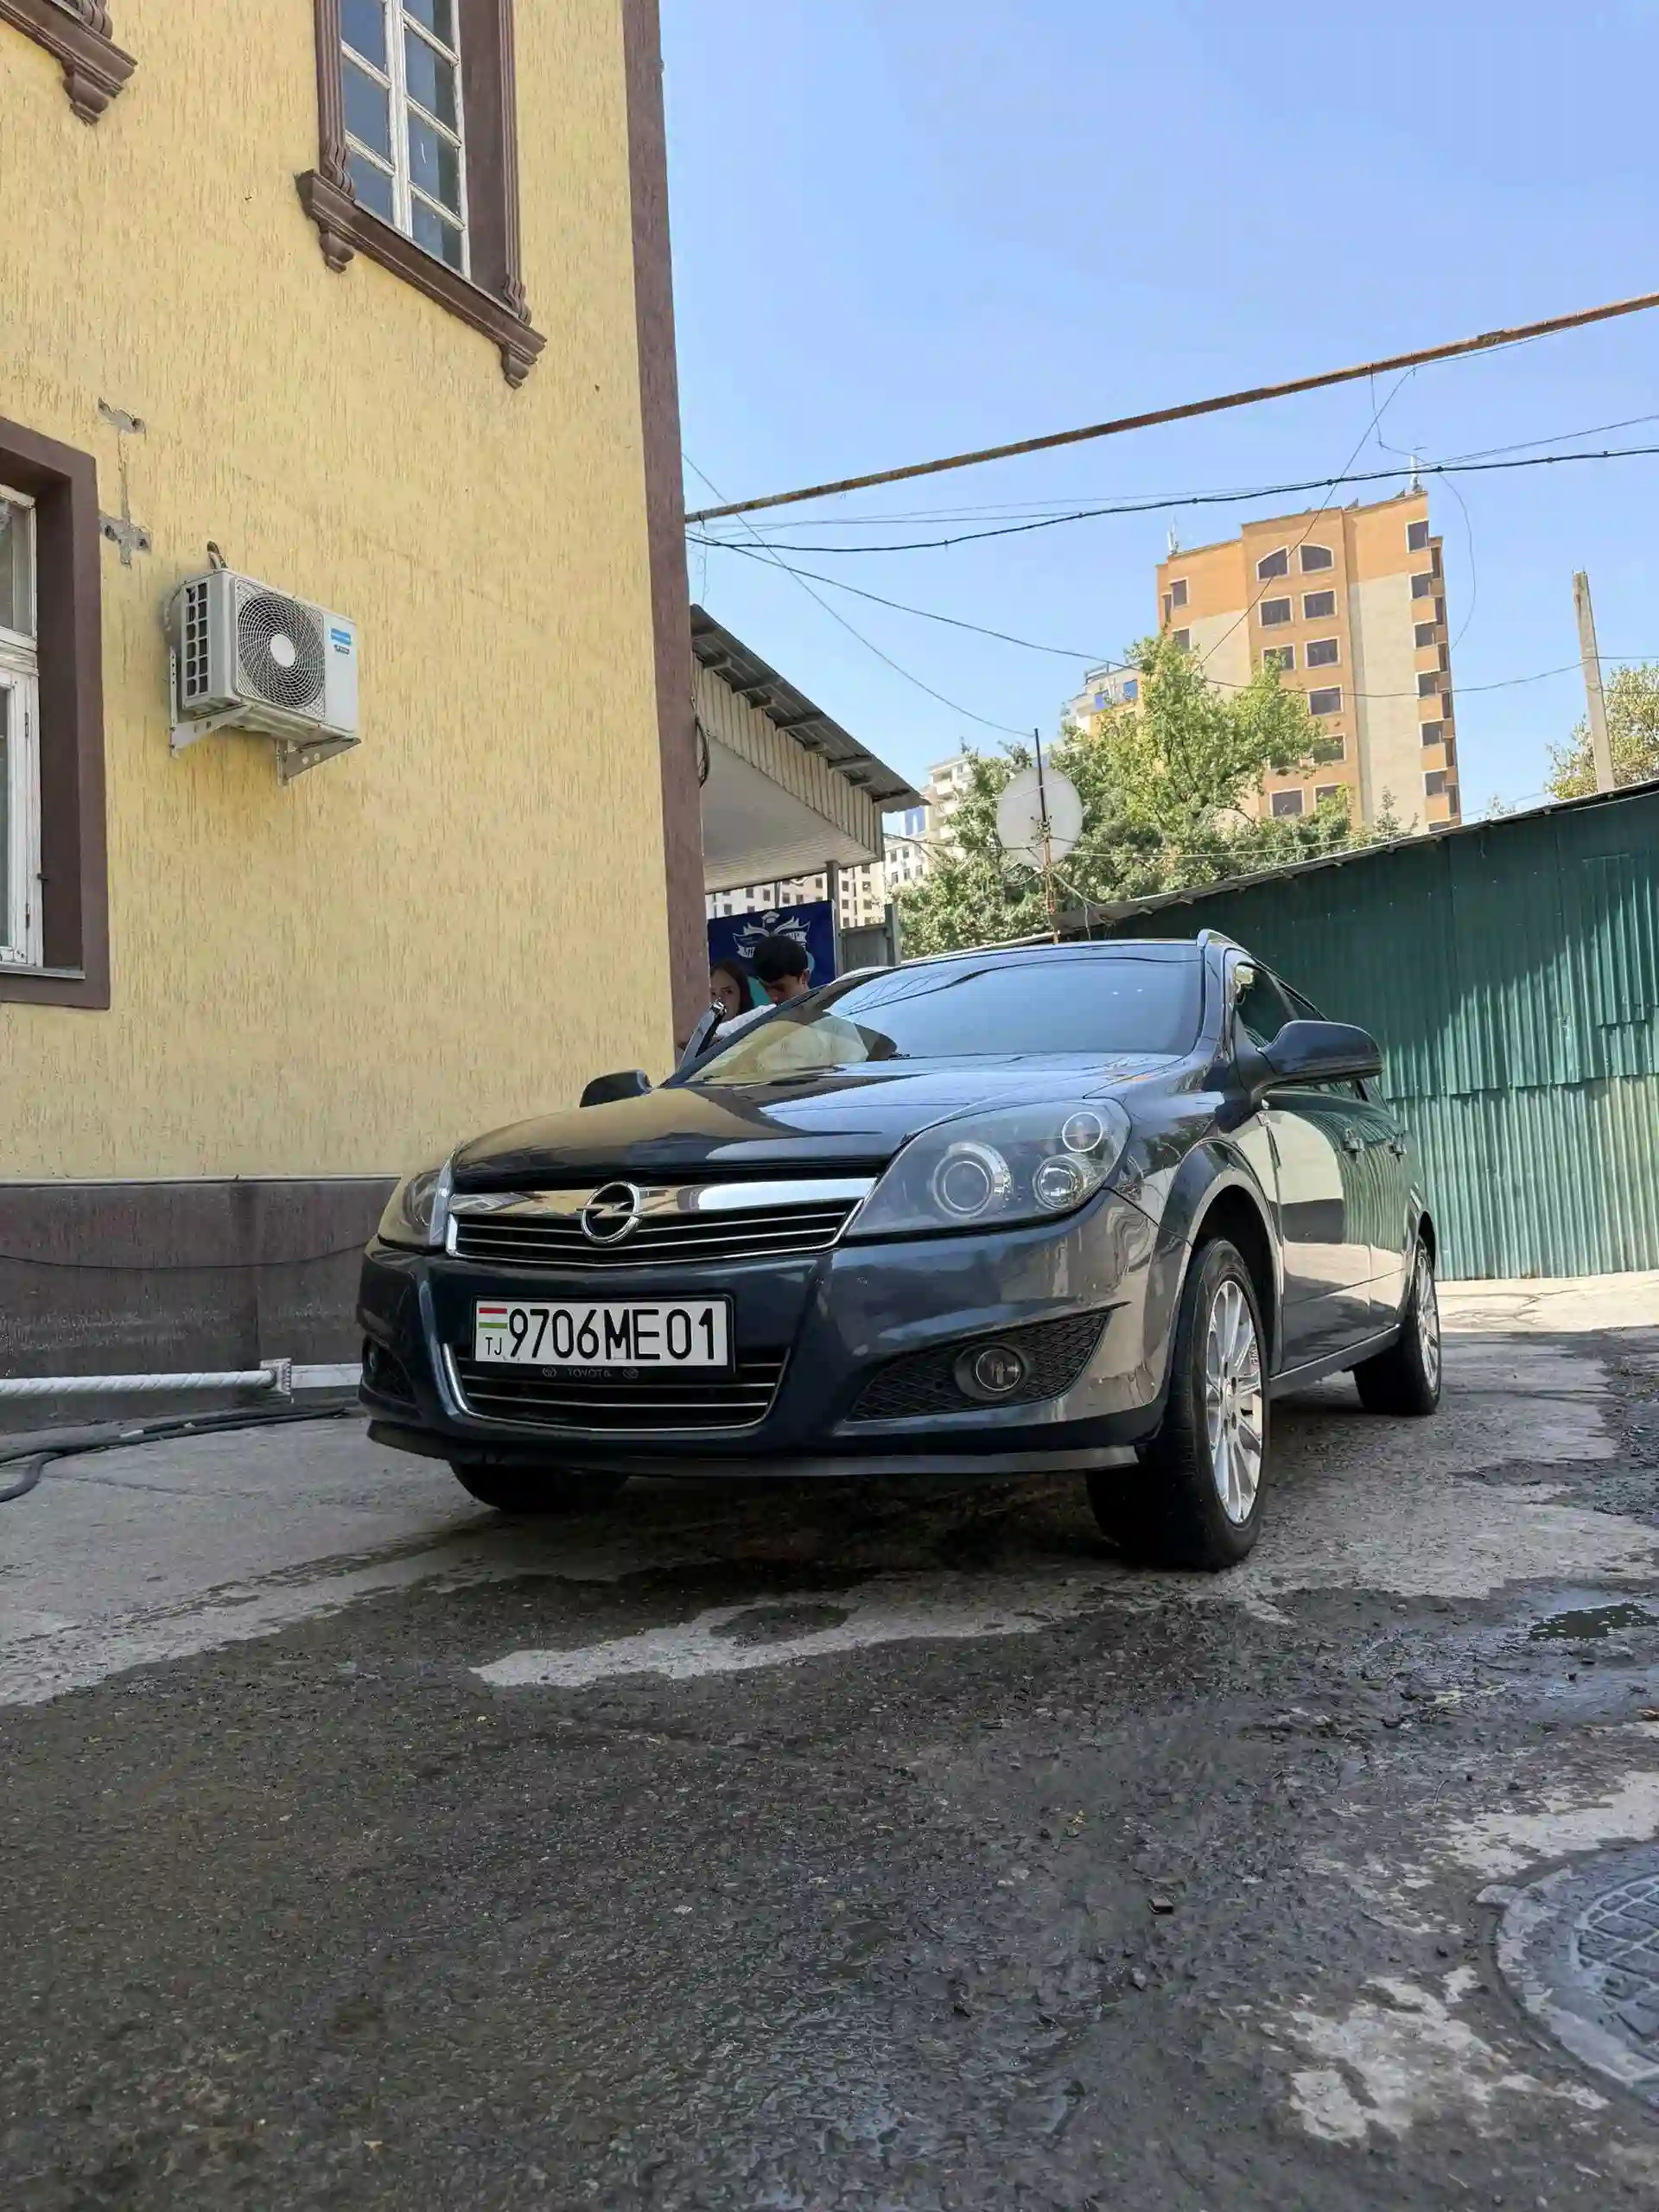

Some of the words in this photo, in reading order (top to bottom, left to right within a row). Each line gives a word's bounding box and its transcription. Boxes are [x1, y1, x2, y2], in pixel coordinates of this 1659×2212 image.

[509, 1308, 715, 1360] 9706ME01
[485, 1337, 503, 1356] TJ
[567, 1368, 613, 1378] TOYOTA
